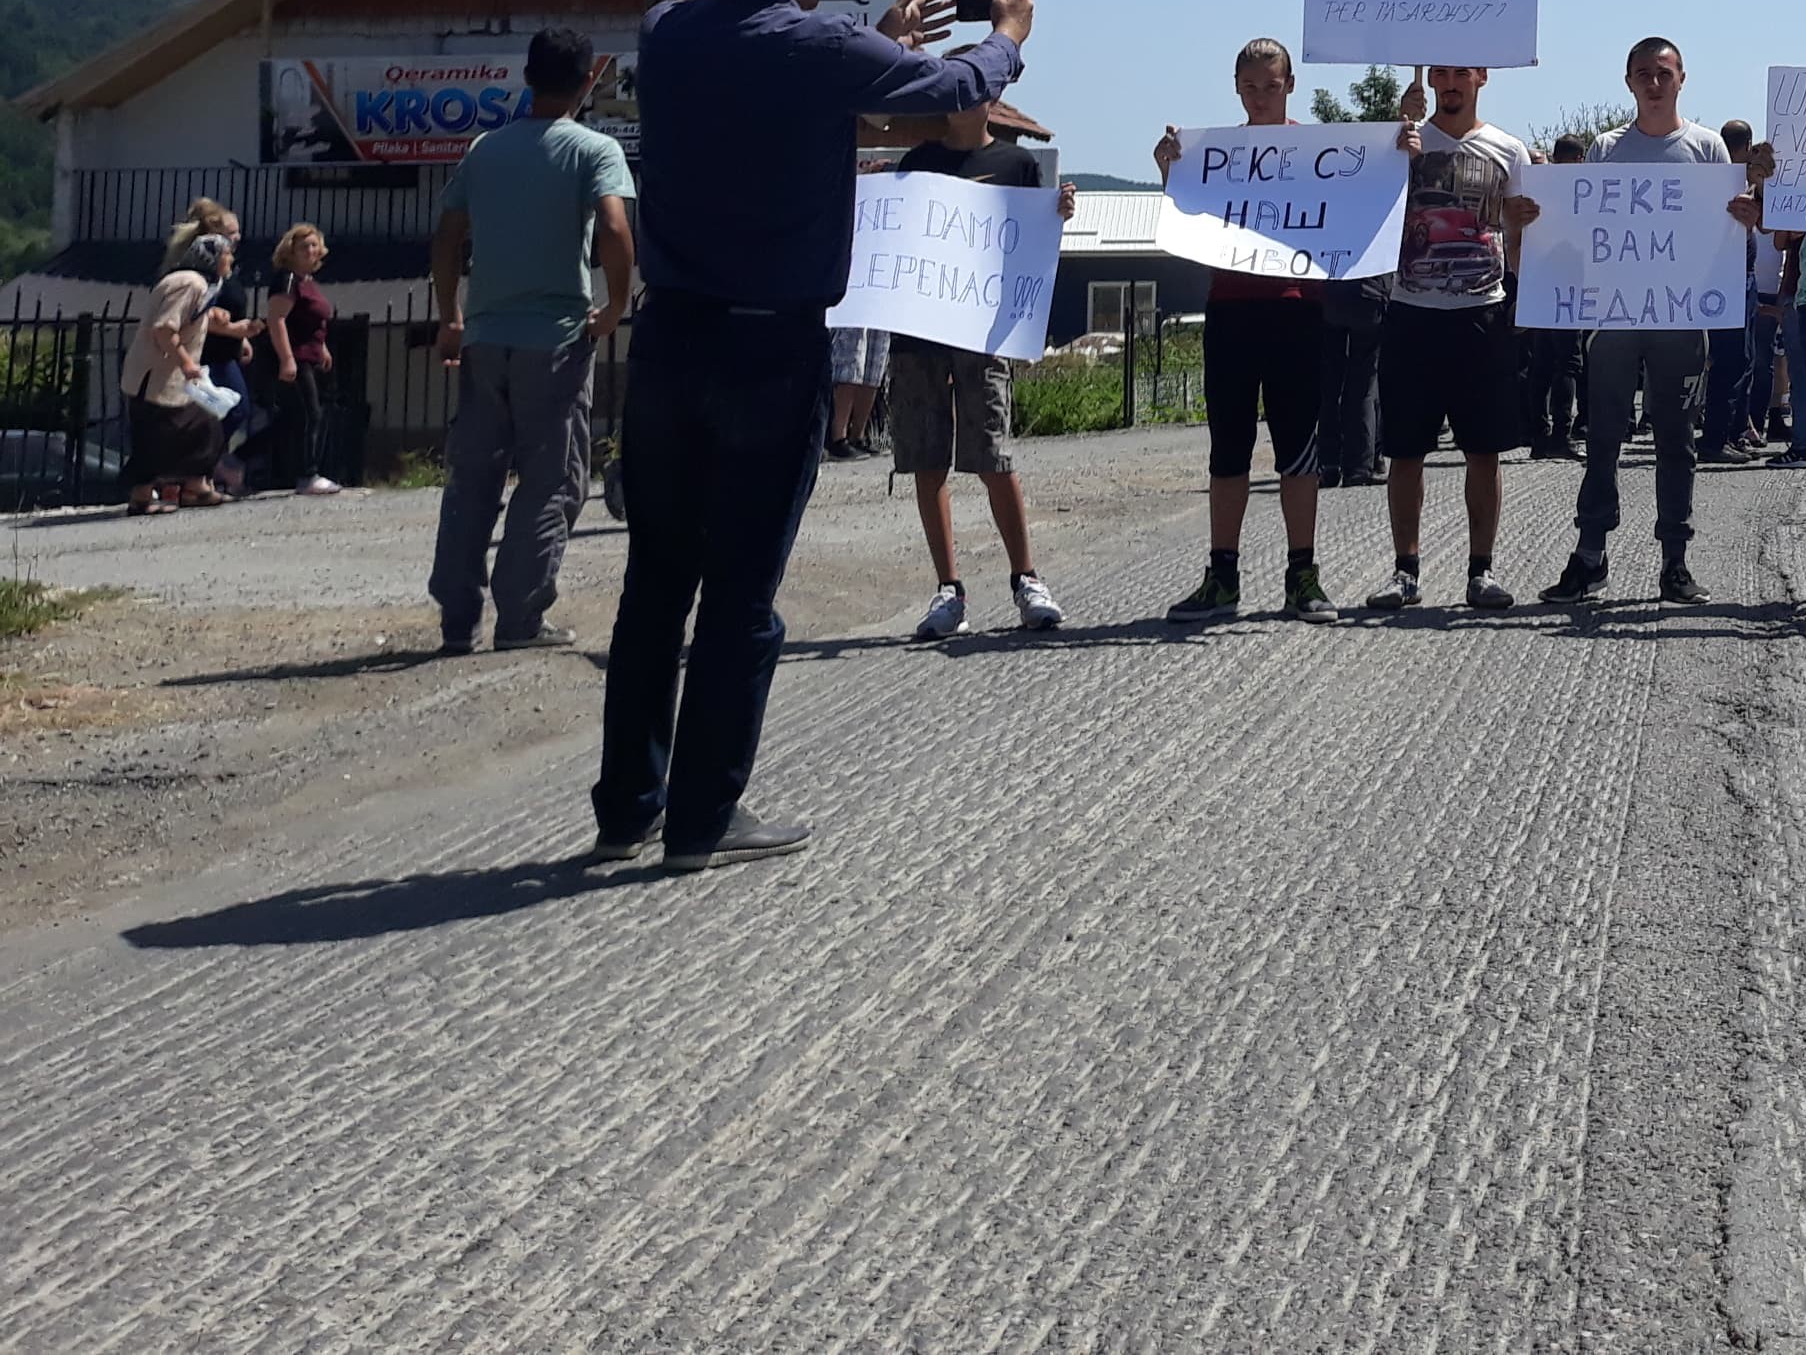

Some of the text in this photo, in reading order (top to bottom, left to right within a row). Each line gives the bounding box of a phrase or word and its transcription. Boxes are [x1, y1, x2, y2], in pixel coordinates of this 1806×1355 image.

[1573, 177, 1684, 215] РЕКЕ
[855, 197, 1020, 255] NE DAMO
[1222, 200, 1327, 231] НАШ
[1221, 246, 1352, 279] ИВОТ
[1591, 227, 1676, 264] ВАМ
[1554, 285, 1727, 327] НЕДАМО
